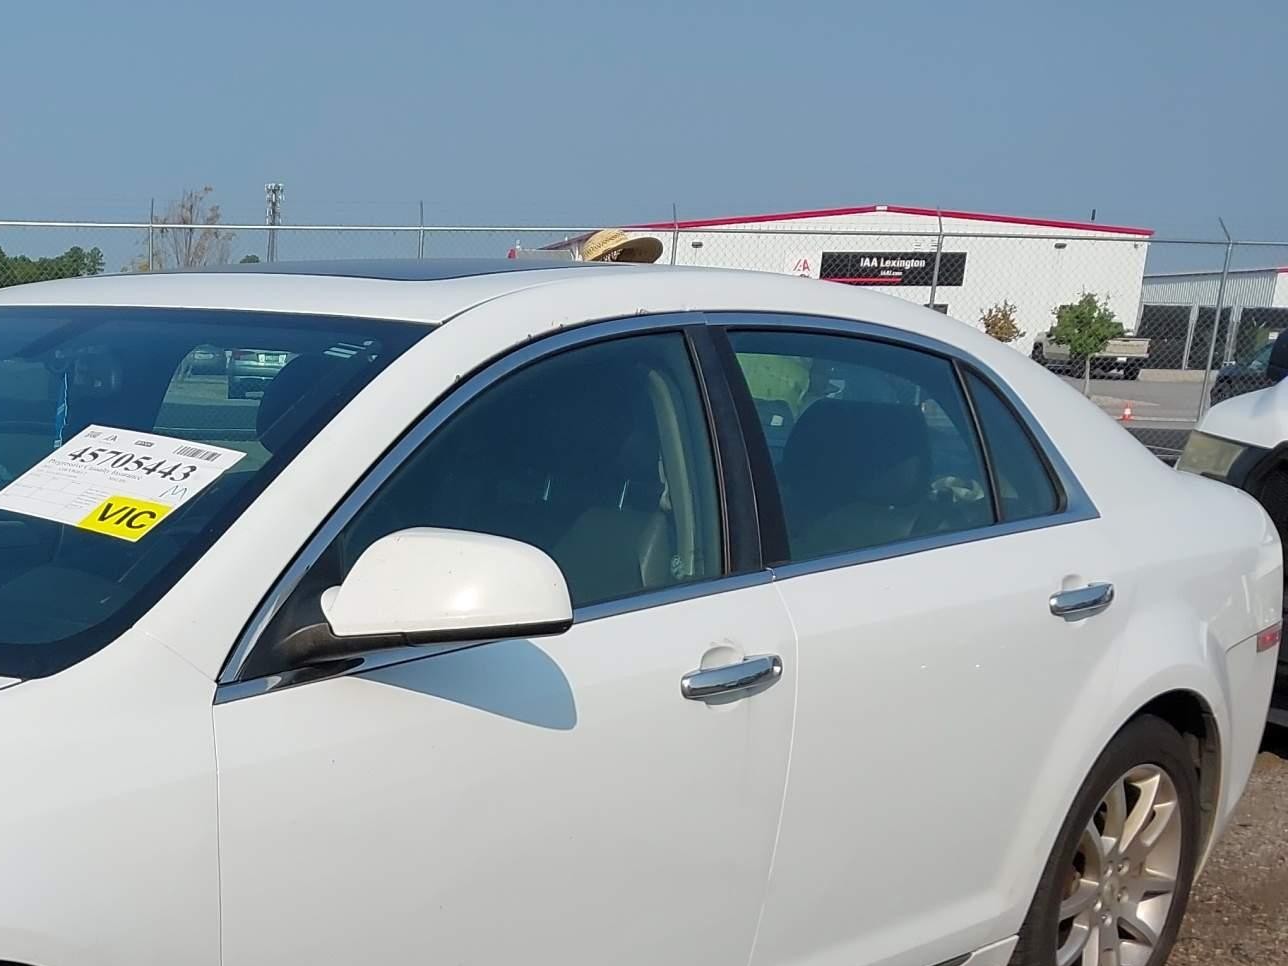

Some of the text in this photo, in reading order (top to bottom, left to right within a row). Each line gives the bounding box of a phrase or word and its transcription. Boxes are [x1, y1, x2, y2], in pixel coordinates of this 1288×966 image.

[859, 257, 926, 270] IAA Lexington
[68, 446, 198, 483] 45705443
[97, 502, 157, 530] VIC
